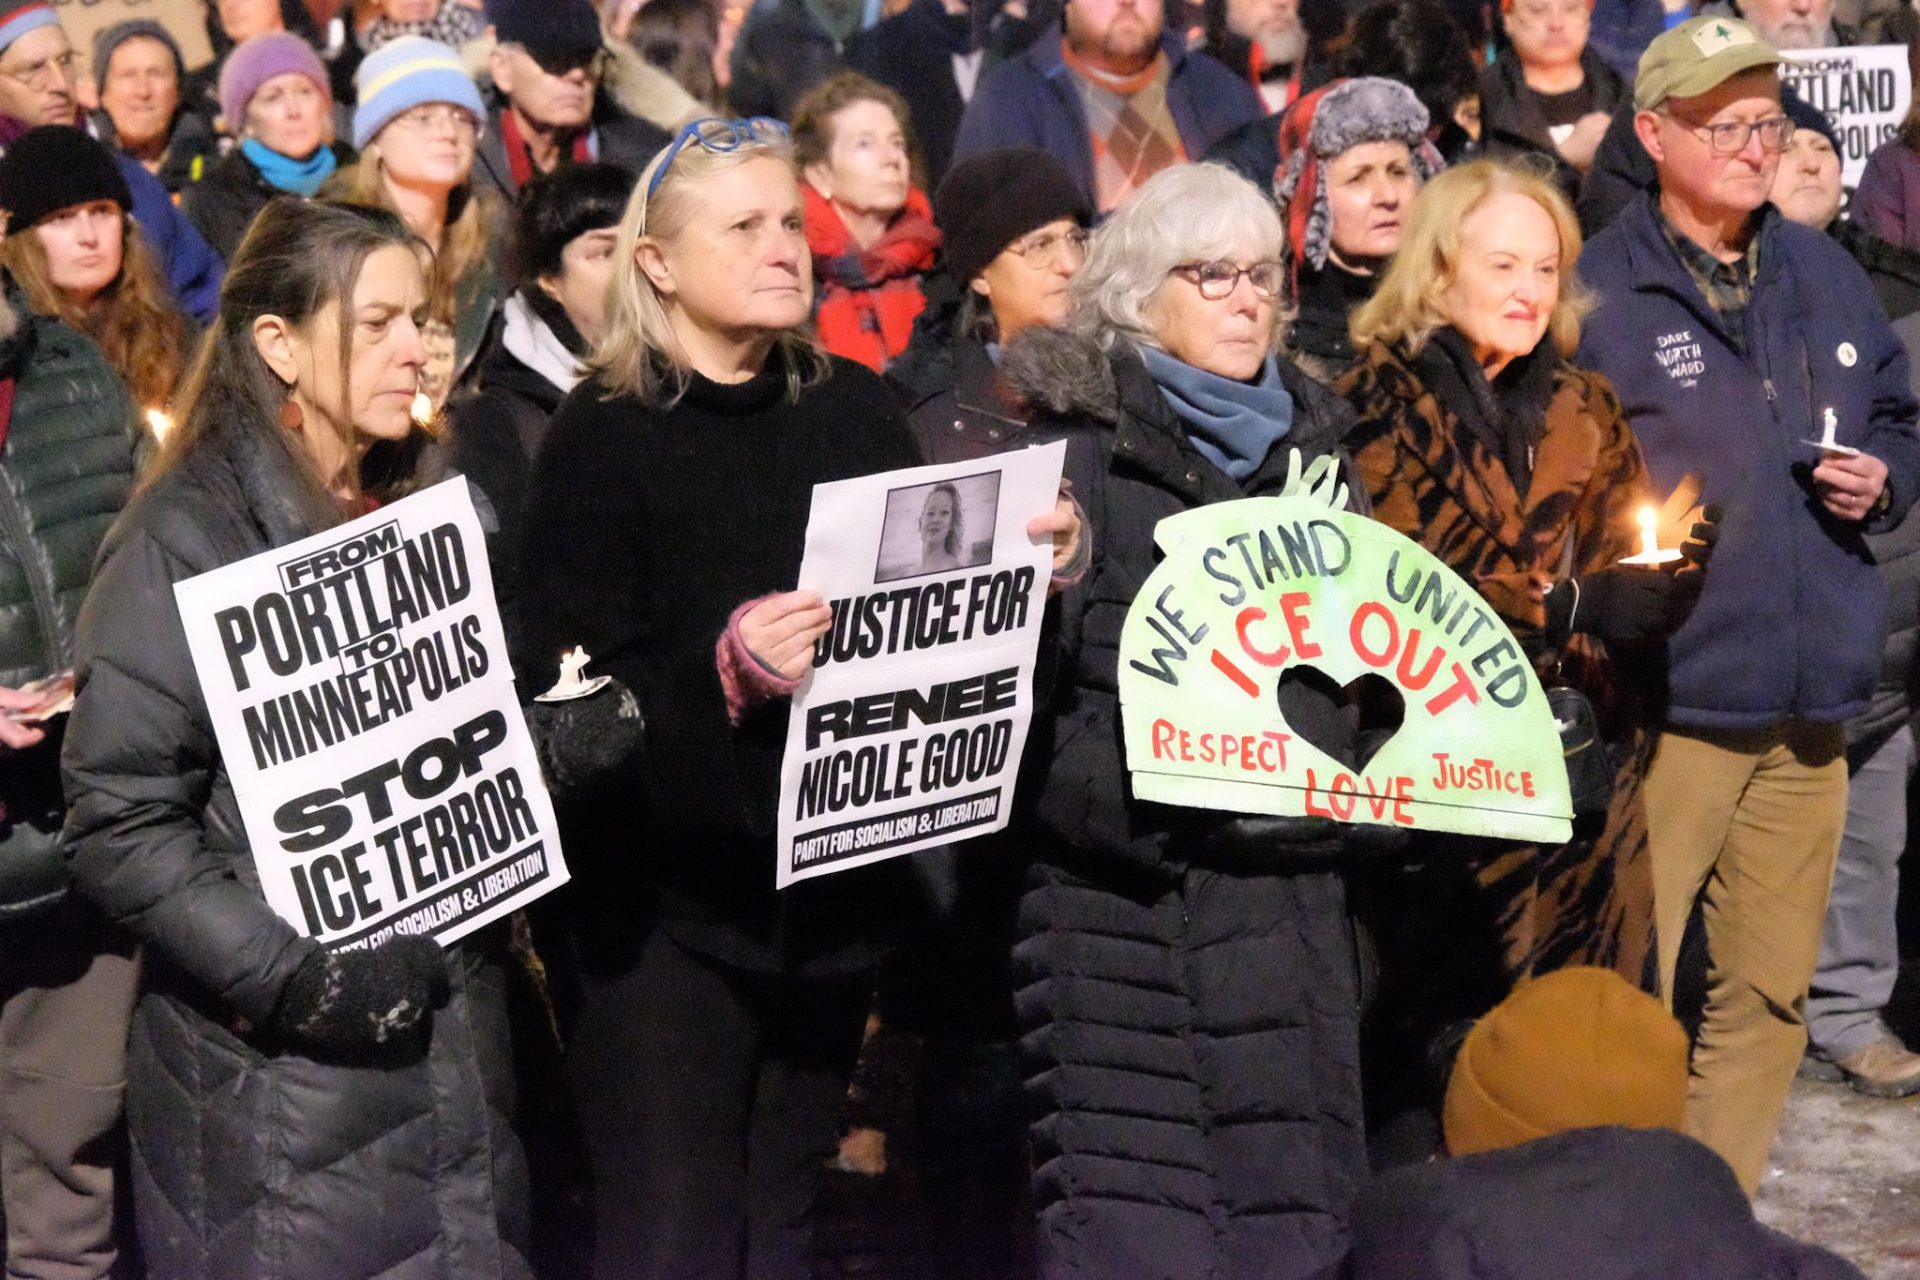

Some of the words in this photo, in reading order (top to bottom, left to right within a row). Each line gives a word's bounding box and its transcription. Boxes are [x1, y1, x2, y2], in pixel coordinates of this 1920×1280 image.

[1655, 344, 1701, 367] NORTH
[1657, 331, 1692, 348] DARE
[1667, 361, 1705, 378] WARD
[285, 526, 400, 588] FROM
[214, 522, 471, 691] PORTLAND
[812, 579, 966, 668] JUSTICE
[963, 565, 1035, 640] FOR
[1130, 585, 1209, 686] WE
[1203, 519, 1351, 606] STAND
[1386, 550, 1529, 708] UNITED
[241, 614, 488, 771] MINNEAPOLIS
[345, 633, 398, 670] TO
[1211, 592, 1323, 698] ICE
[1349, 602, 1481, 717] OUT
[805, 666, 1019, 751] RENEE
[1152, 719, 1291, 773] RESPECT
[273, 710, 507, 853] STOP
[795, 739, 917, 821] NICOLE
[920, 719, 1013, 789] GOOD
[1305, 768, 1415, 825] LOVE
[1433, 753, 1536, 797] JUSTICE
[290, 841, 383, 936] ICE
[374, 767, 539, 902] TERROR
[794, 834, 830, 865] PARTY
[830, 829, 854, 855] FOR
[855, 815, 917, 849] SOCIALISM
[918, 813, 932, 834] &
[934, 795, 998, 828] LIBERATION
[395, 894, 462, 937] SOCIALISM
[462, 887, 480, 911] &
[478, 851, 544, 901] LIBERATION
